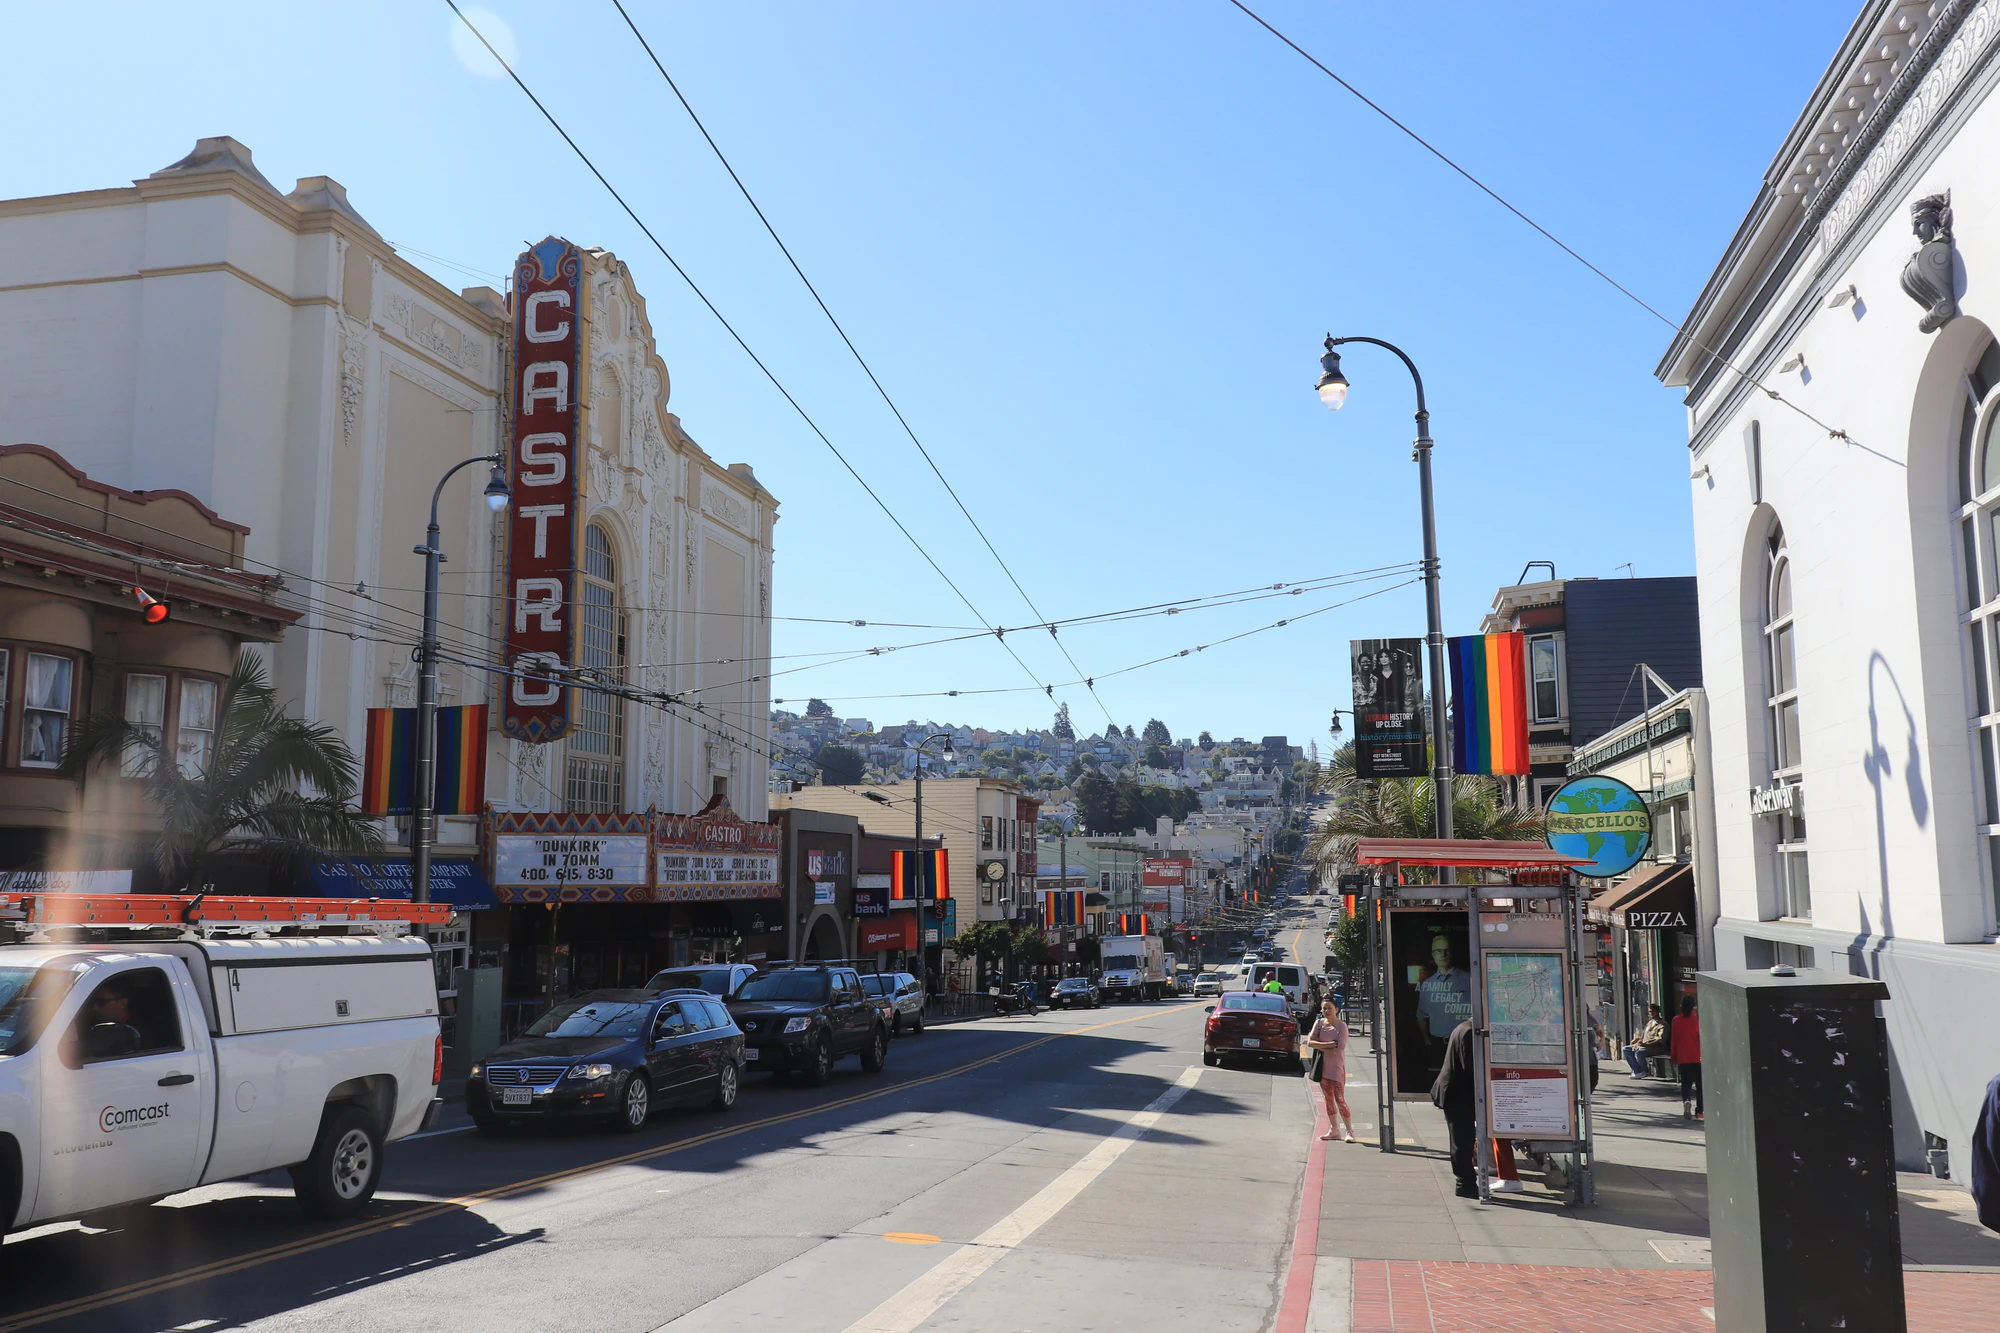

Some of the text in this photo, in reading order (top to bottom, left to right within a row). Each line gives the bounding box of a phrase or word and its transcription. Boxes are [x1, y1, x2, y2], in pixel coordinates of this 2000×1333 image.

[512, 289, 570, 706] CASTRO
[1389, 713, 1414, 721] HISTORY
[1360, 732, 1421, 742] history museum
[704, 825, 742, 843] CASTRO
[535, 840, 607, 853] "DUNKIRK"
[543, 854, 600, 866] IN 70MM
[320, 863, 472, 877] CASO OFFE OMPANY
[587, 868, 614, 880] 8:30
[51, 875, 72, 892] dog
[856, 893, 870, 903] us
[855, 902, 884, 914] bank
[1629, 911, 1688, 928] PIZZA
[232, 969, 240, 992] 4
[1414, 981, 1453, 992] A FAMILY
[1430, 992, 1463, 1003] LEGACY
[1505, 1070, 1521, 1079] info
